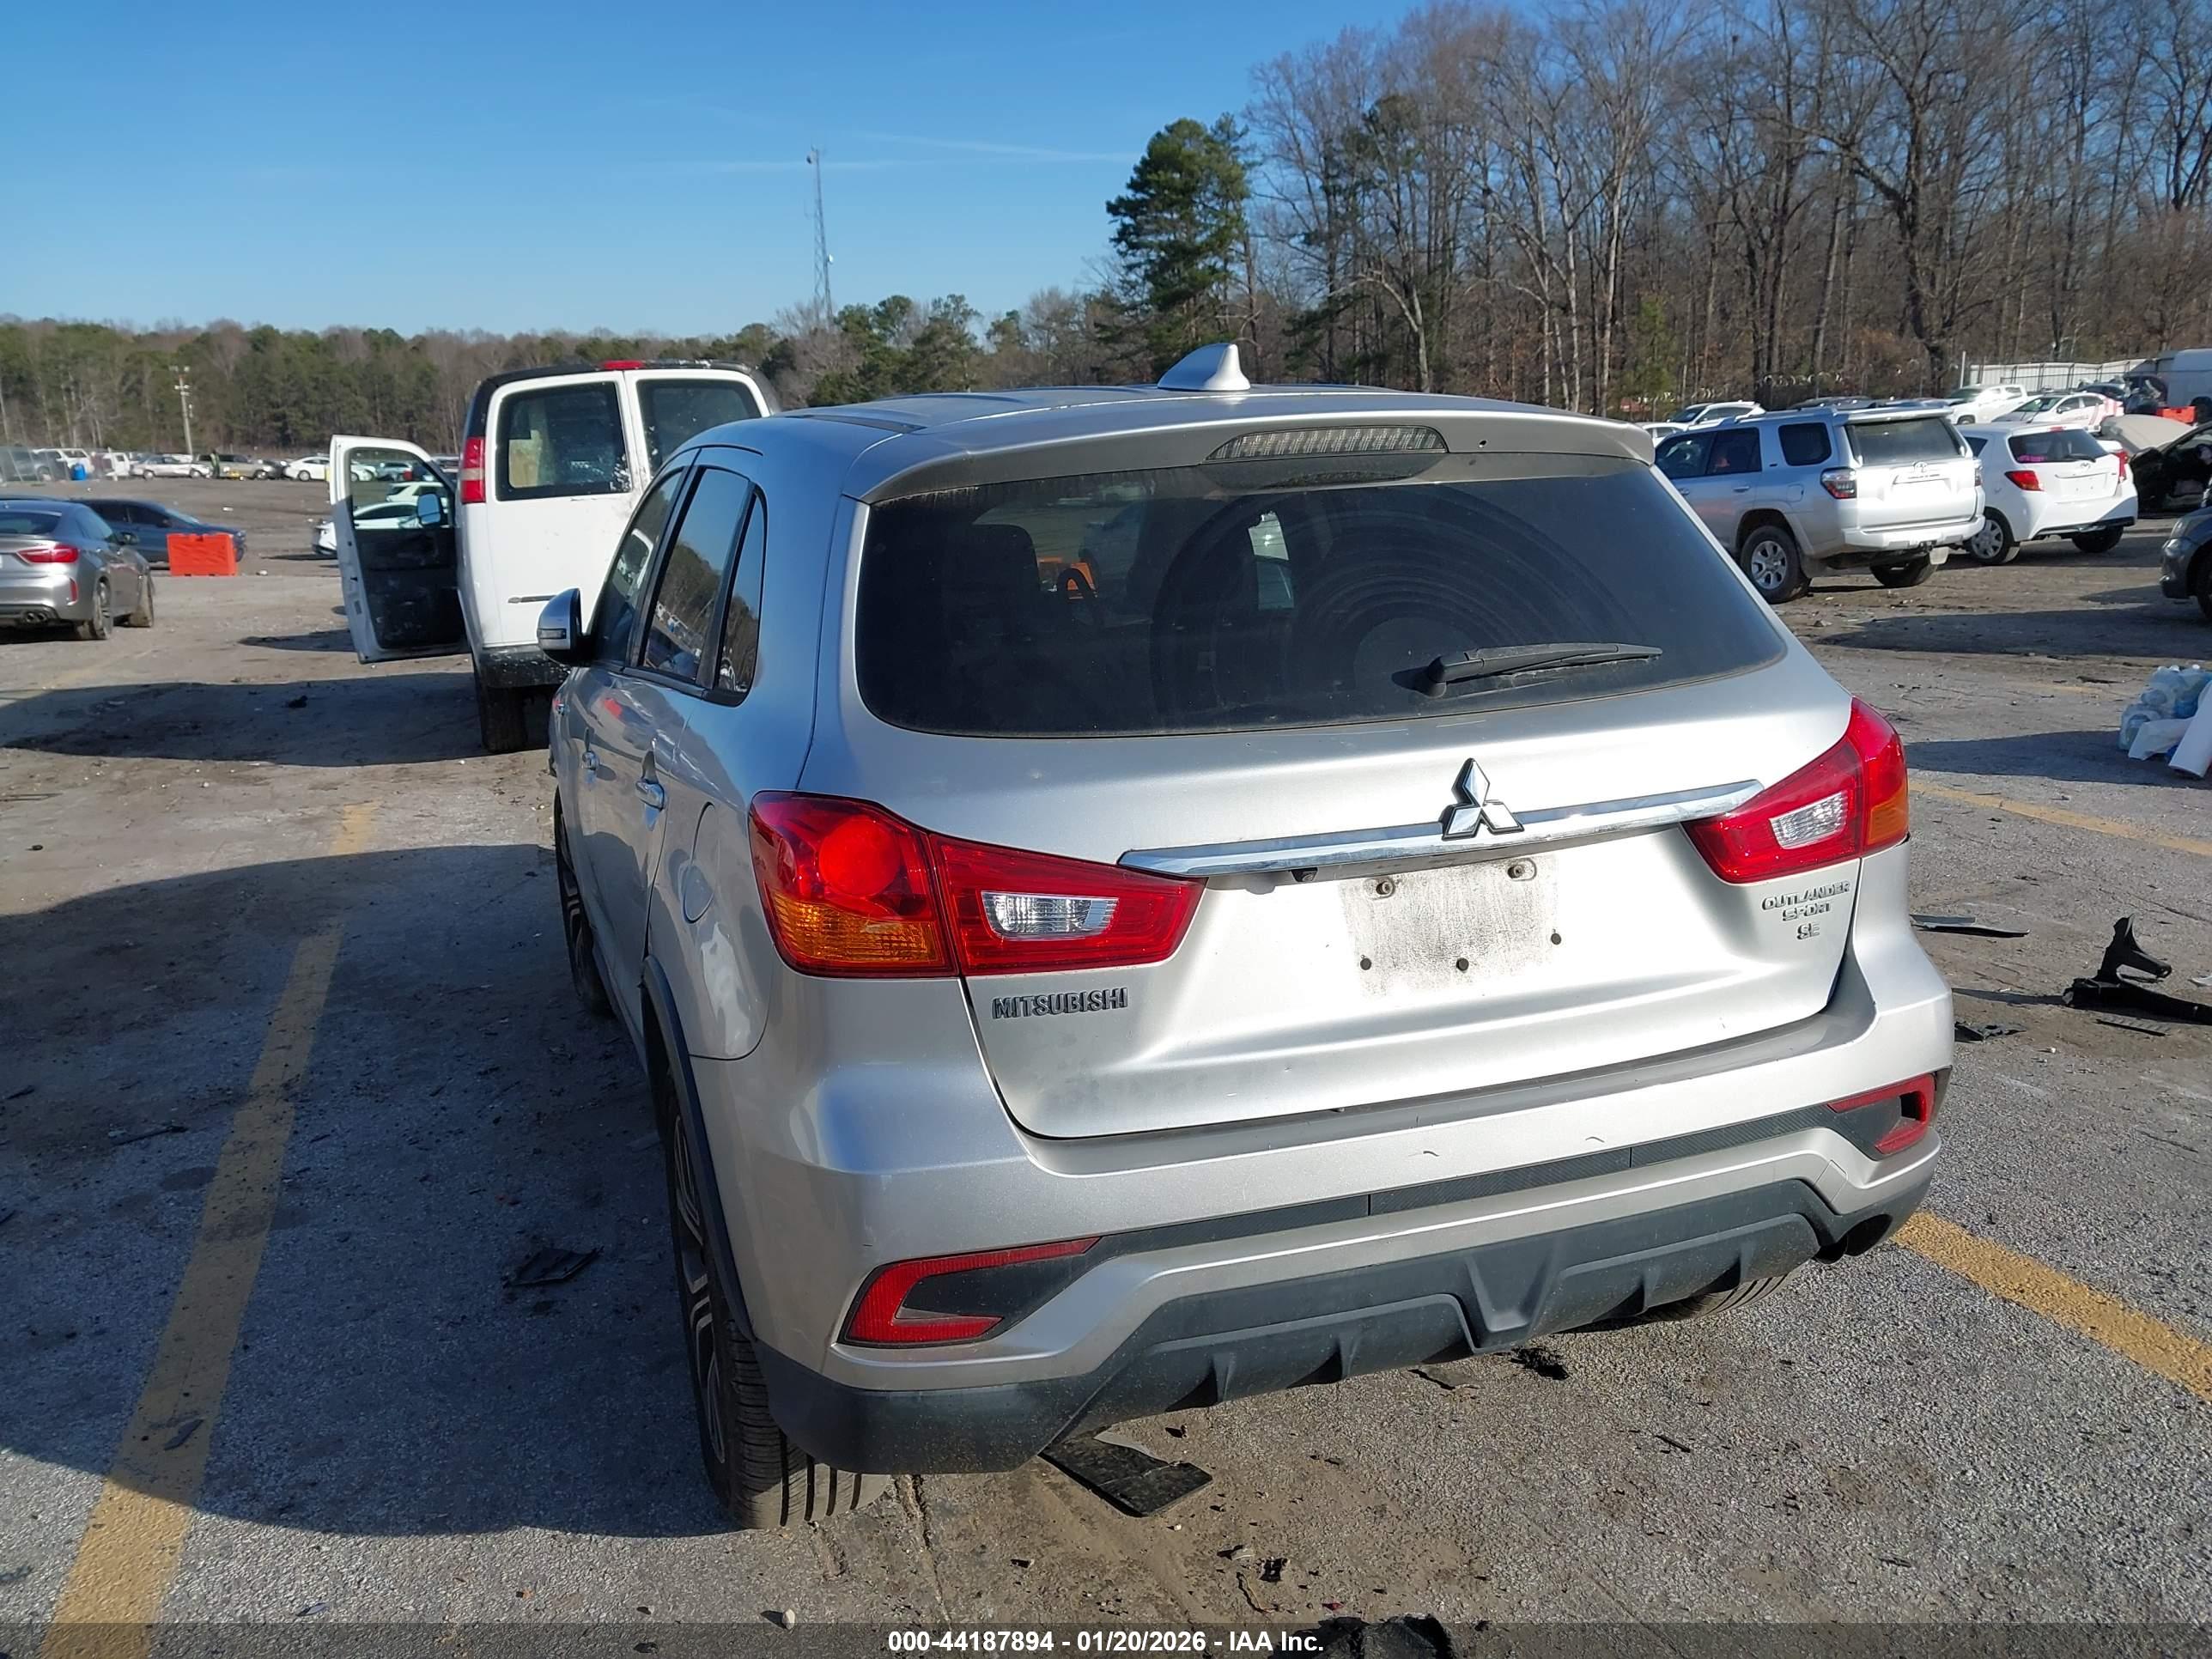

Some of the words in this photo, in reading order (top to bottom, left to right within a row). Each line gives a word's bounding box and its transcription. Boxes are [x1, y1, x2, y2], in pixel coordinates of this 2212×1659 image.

[1761, 880, 1850, 910] OUTLANDER
[1782, 900, 1832, 921] SPORT
[1796, 922, 1820, 939] SE
[992, 988, 1128, 1019] MITSUBISHI
